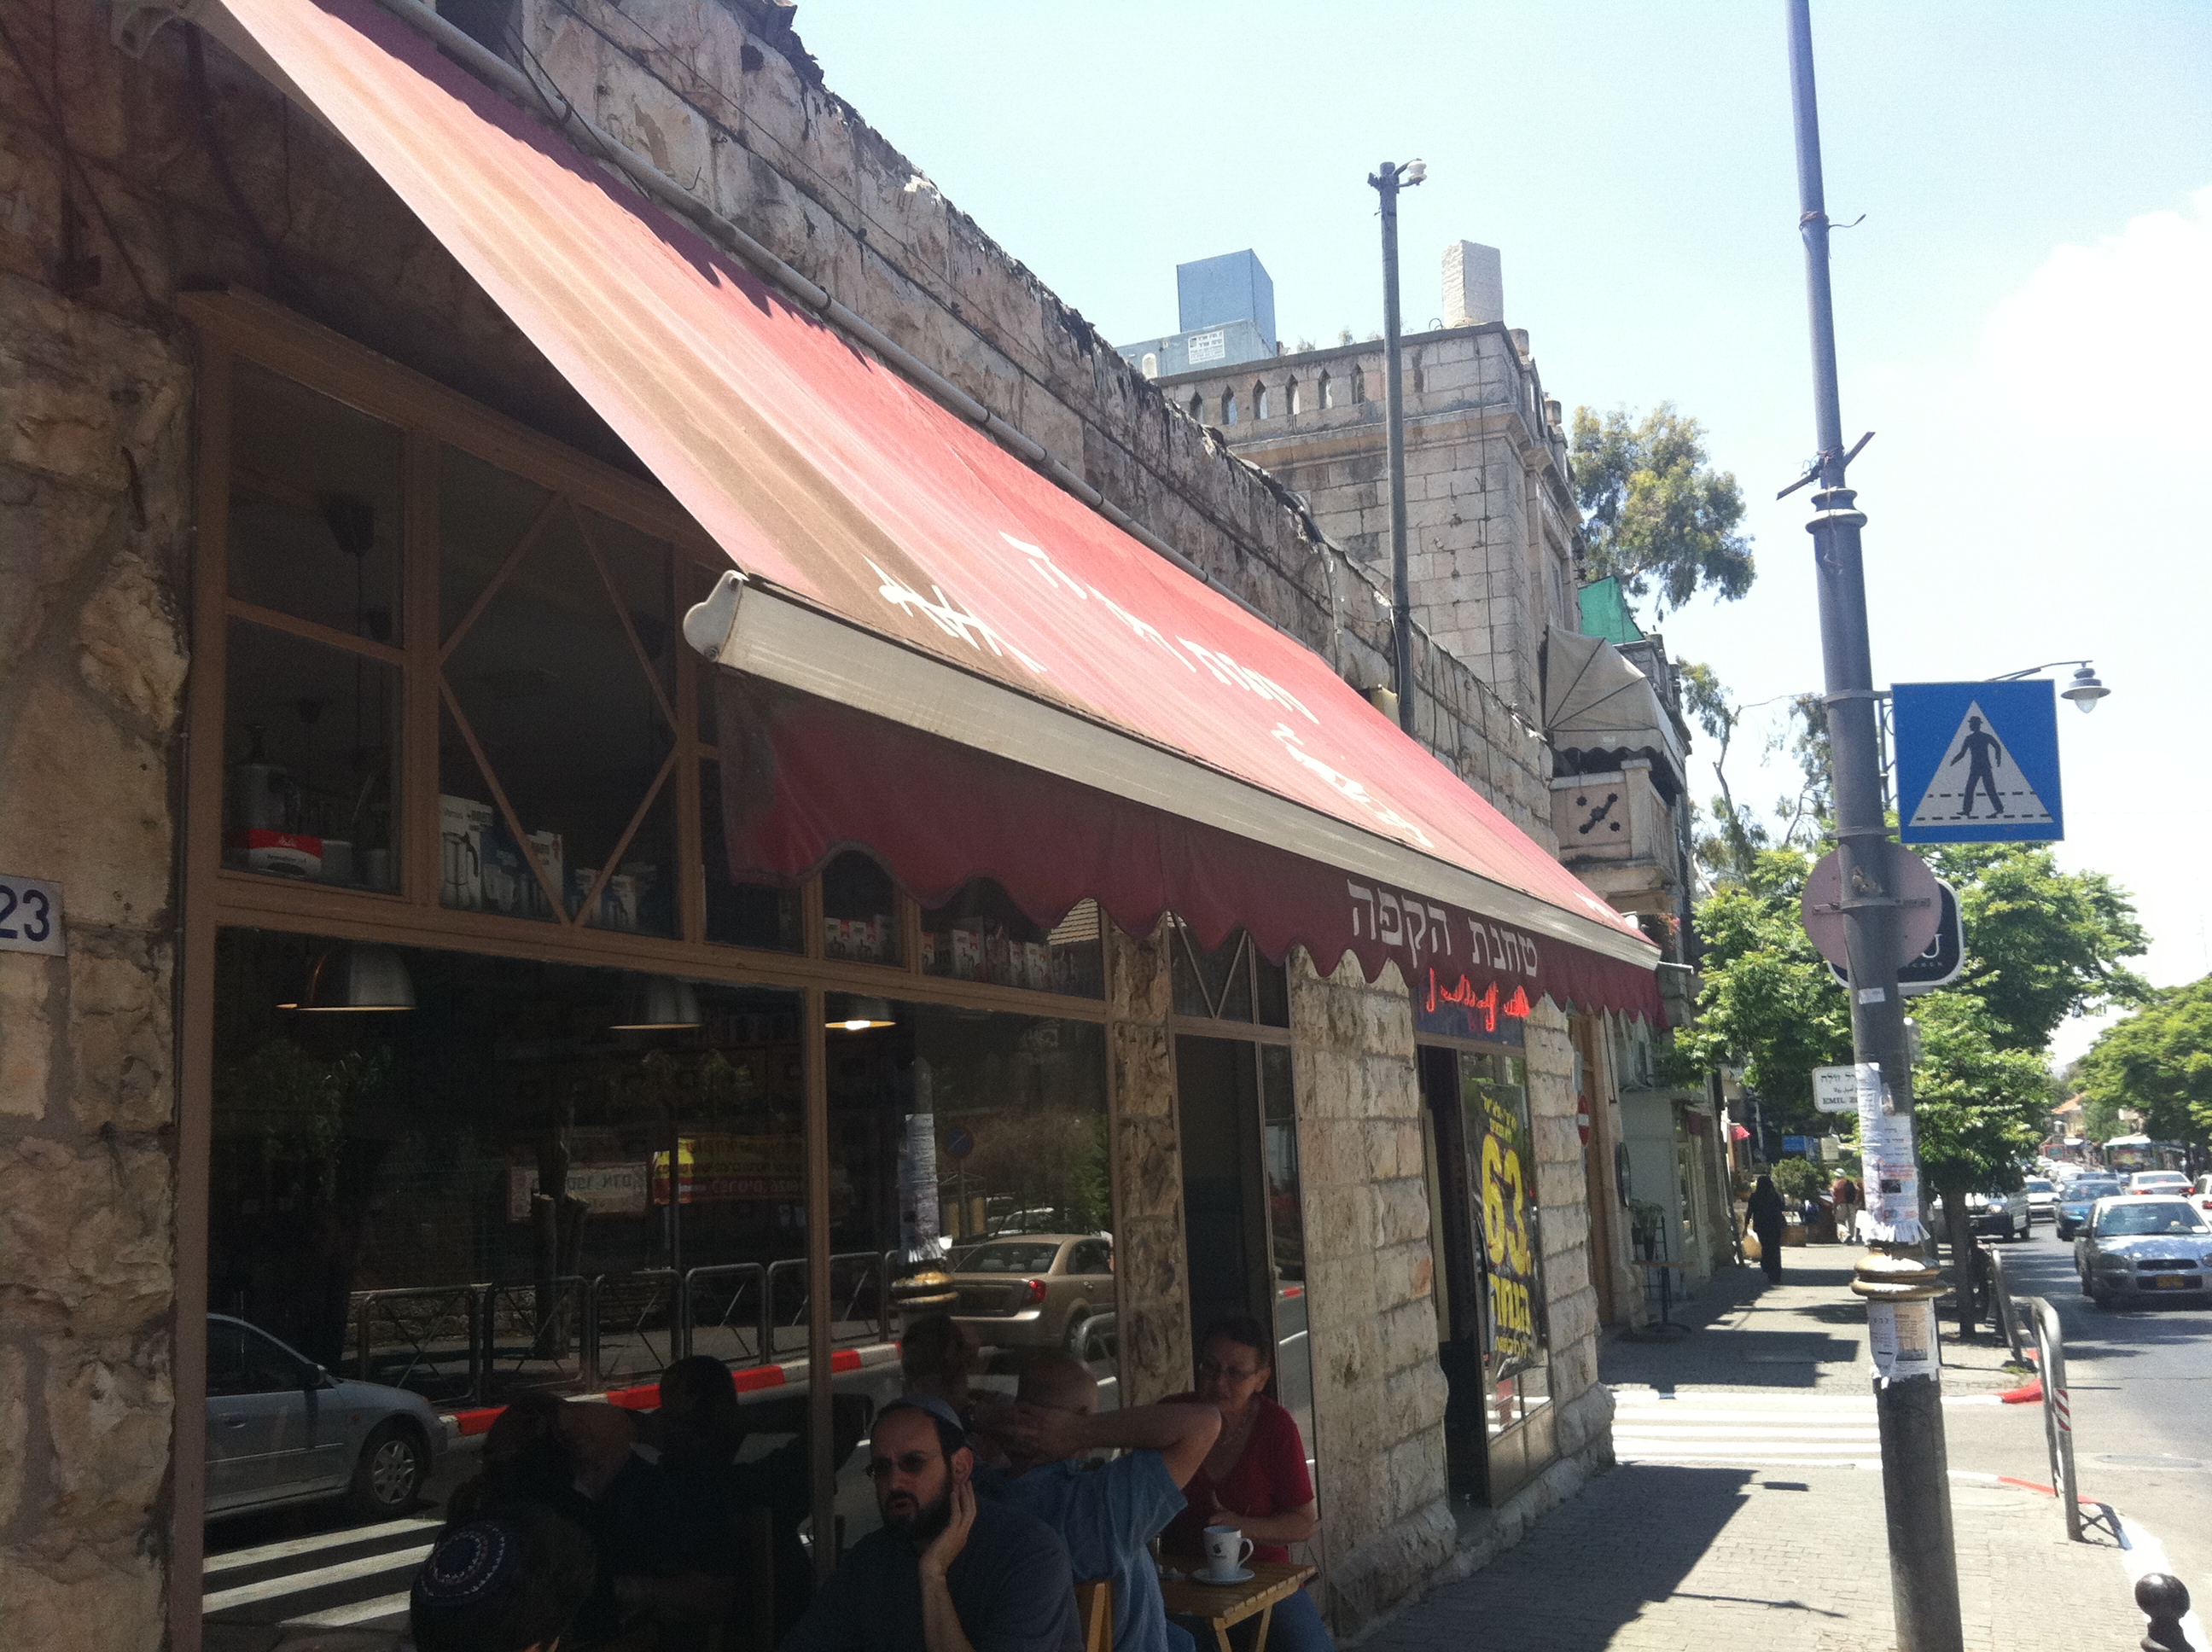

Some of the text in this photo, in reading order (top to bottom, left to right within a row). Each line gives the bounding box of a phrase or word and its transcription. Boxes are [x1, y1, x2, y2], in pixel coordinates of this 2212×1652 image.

[0, 884, 49, 942] 23
[1347, 879, 1537, 977] טחנת הקפה
[1822, 1096, 1846, 1105] EMIL
